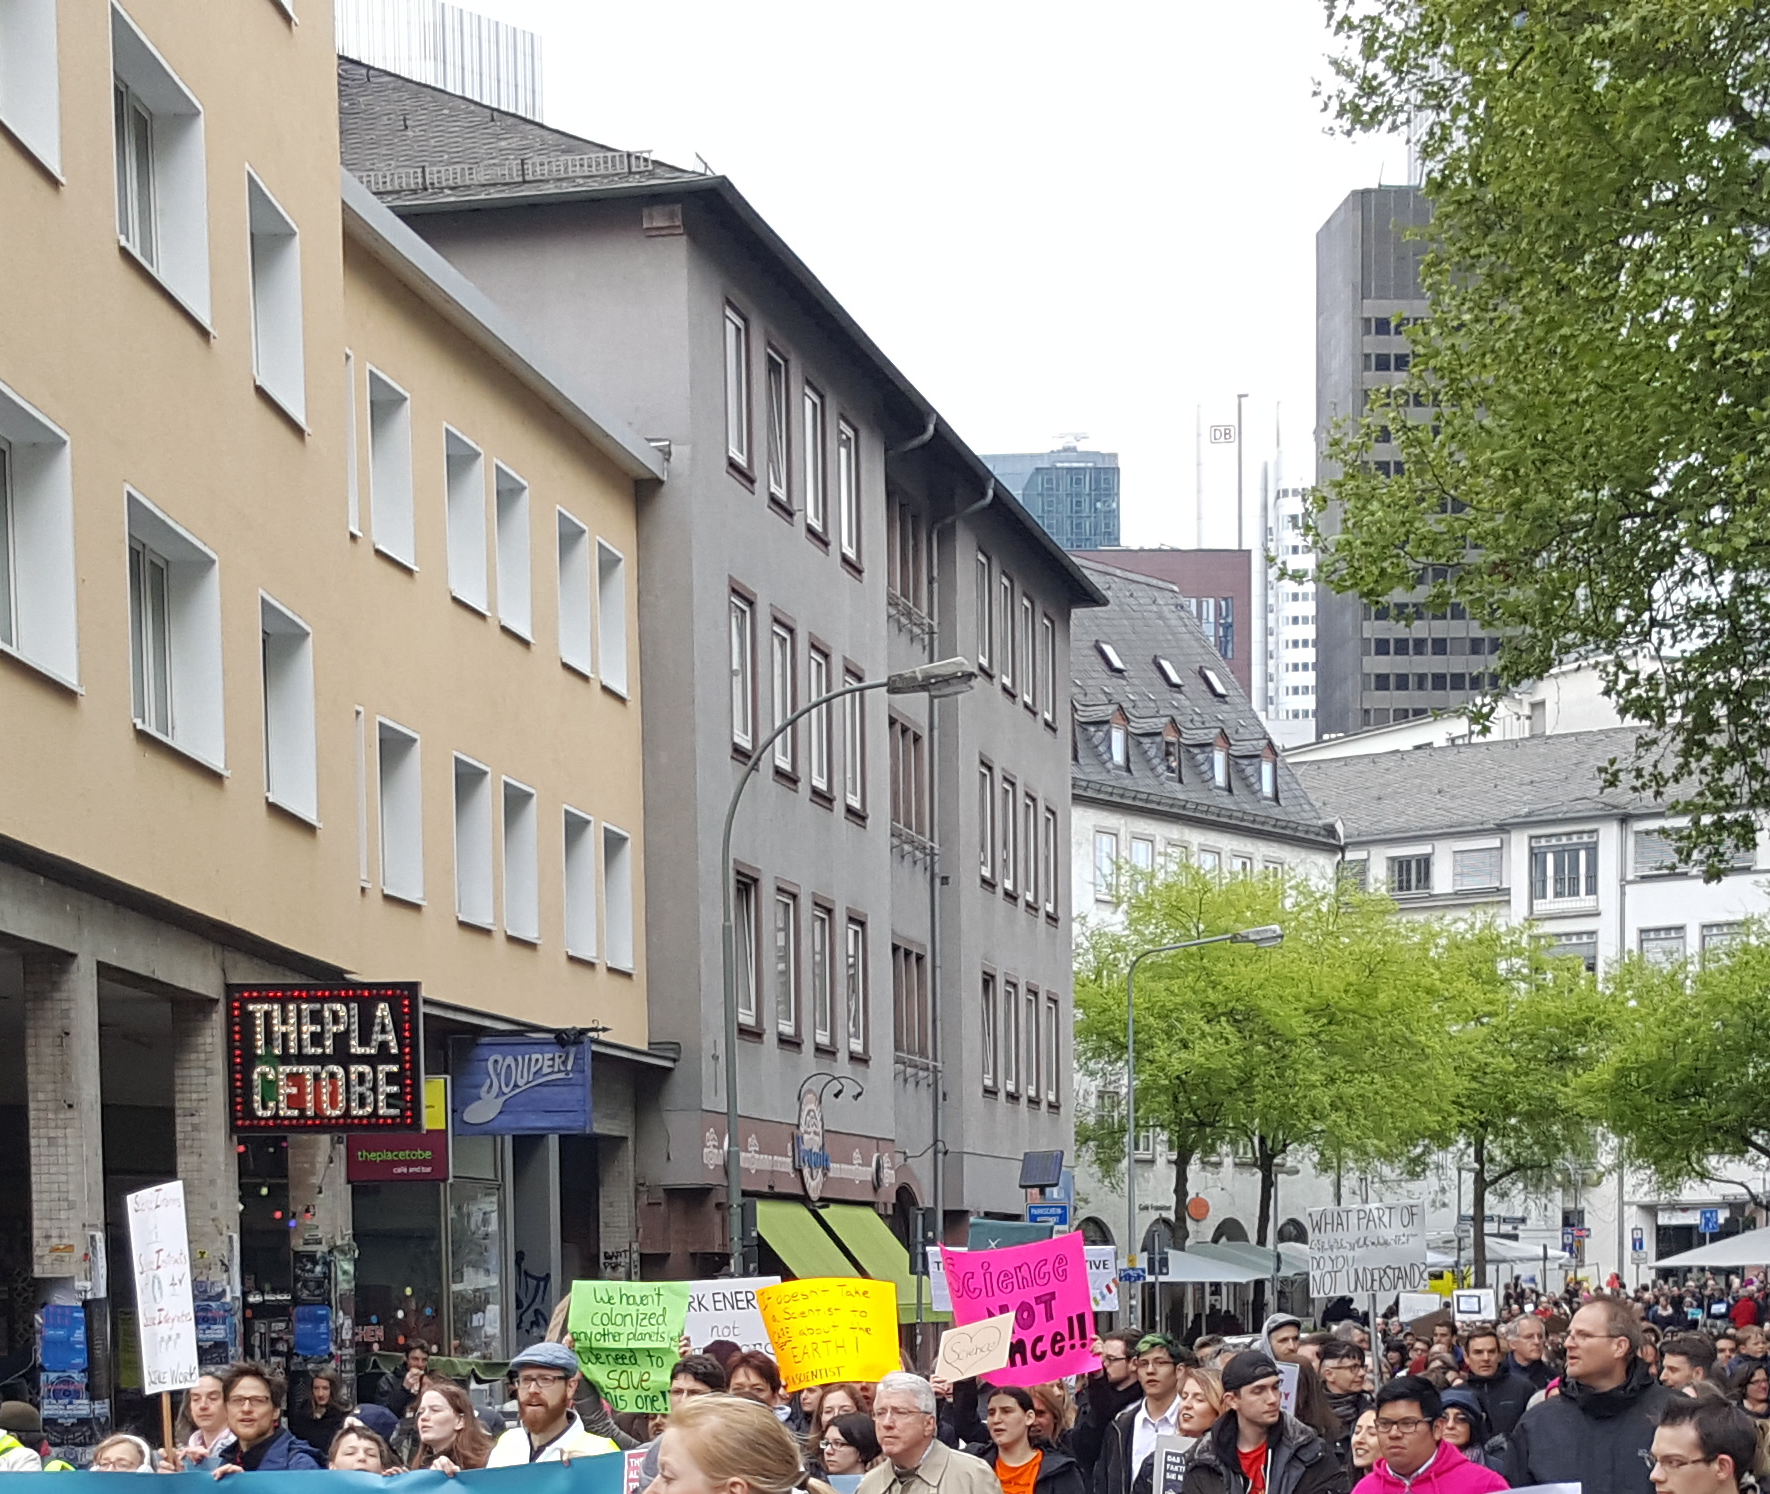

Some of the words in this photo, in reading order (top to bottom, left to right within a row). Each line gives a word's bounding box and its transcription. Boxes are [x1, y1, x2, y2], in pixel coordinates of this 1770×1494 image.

[1214, 428, 1232, 440] DB
[247, 1002, 400, 1055] THEPLA
[480, 1047, 575, 1100] SOUPER!
[252, 1064, 401, 1117] CETOBE
[358, 1148, 433, 1163] theplacetobe
[1309, 1208, 1353, 1234] WHAT
[1356, 1206, 1396, 1231] PART
[1400, 1205, 1419, 1228] OF
[1311, 1256, 1326, 1271] DO
[1329, 1254, 1355, 1270] YOU
[945, 1254, 1068, 1299] Science
[1311, 1270, 1342, 1295] NOT
[1346, 1261, 1428, 1293] UNDERSTAND?
[593, 1287, 615, 1305] We
[619, 1287, 663, 1306] haven't
[687, 1293, 710, 1312] RK
[712, 1291, 757, 1311] ENER
[776, 1287, 829, 1305] doesn't
[837, 1284, 871, 1299] Take
[591, 1307, 667, 1327] colonized
[783, 1306, 841, 1321] Scientist
[850, 1308, 868, 1318] to
[626, 1327, 666, 1347] planets
[710, 1321, 742, 1338] not
[799, 1324, 839, 1337] about
[850, 1321, 873, 1336] the
[1009, 1312, 1088, 1368] nce!!
[577, 1349, 602, 1365] We
[605, 1349, 640, 1366] need
[647, 1350, 665, 1368] to
[605, 1369, 651, 1391] save
[635, 1391, 670, 1412] one!
